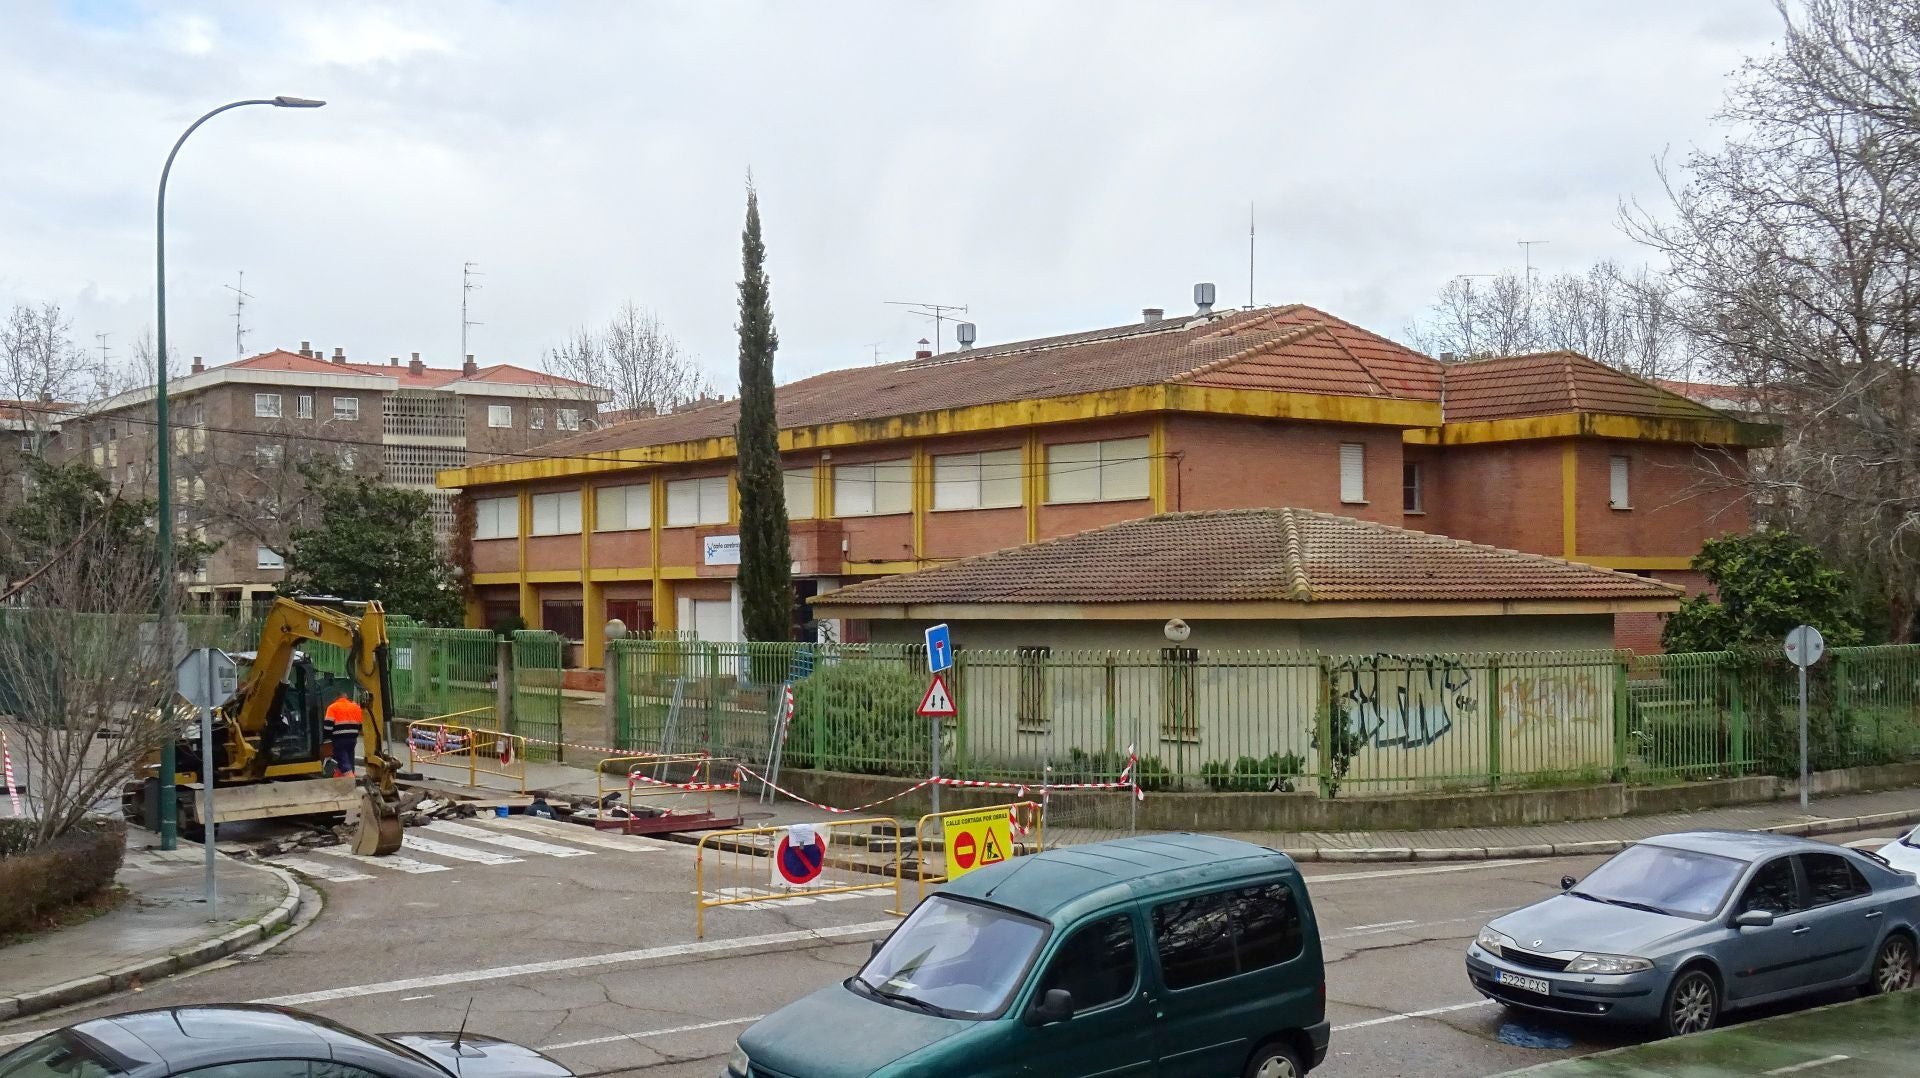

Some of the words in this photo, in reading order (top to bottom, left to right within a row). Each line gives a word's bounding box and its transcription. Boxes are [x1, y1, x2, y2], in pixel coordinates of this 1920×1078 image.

[308, 618, 321, 634] CAT
[946, 818, 961, 827] CALLE
[962, 815, 982, 826] CORTADA
[983, 813, 992, 823] POR
[993, 811, 1008, 821] OBRAS
[1502, 973, 1525, 988] 5229
[1527, 978, 1547, 993] CXS
